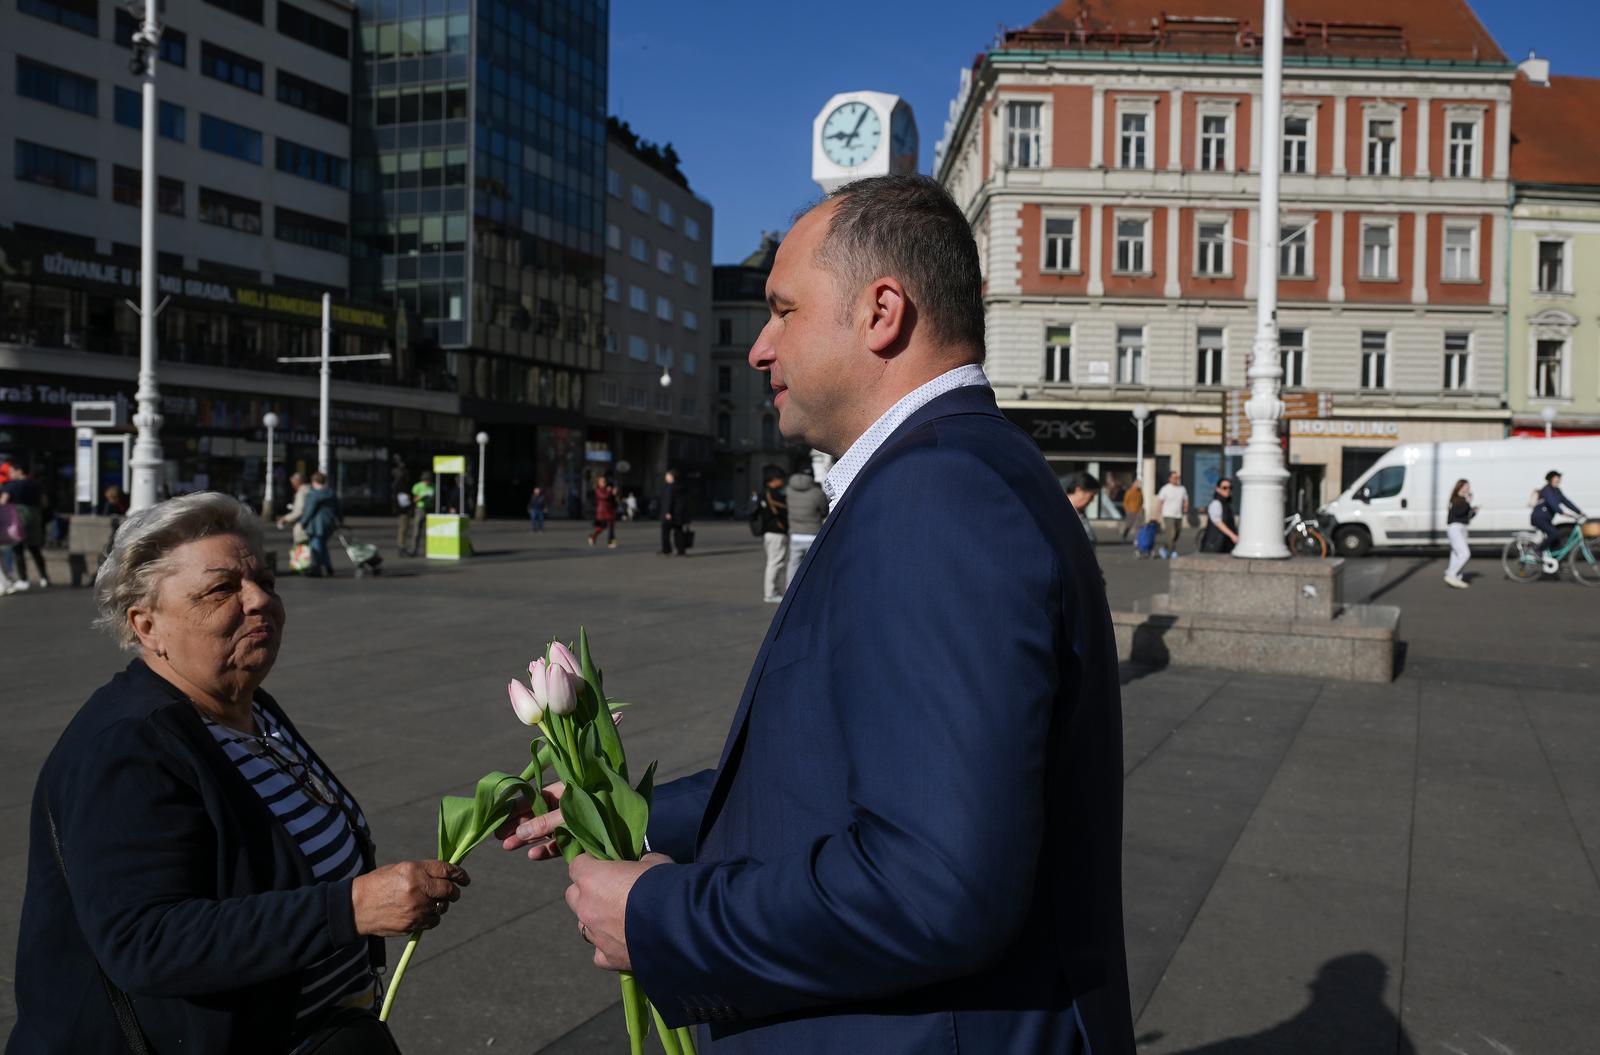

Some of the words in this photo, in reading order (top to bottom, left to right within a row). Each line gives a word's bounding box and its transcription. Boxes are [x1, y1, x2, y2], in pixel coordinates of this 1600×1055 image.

[121, 267, 133, 287] U
[1032, 419, 1096, 439] ZAKS
[1297, 421, 1398, 434] HOLDING
